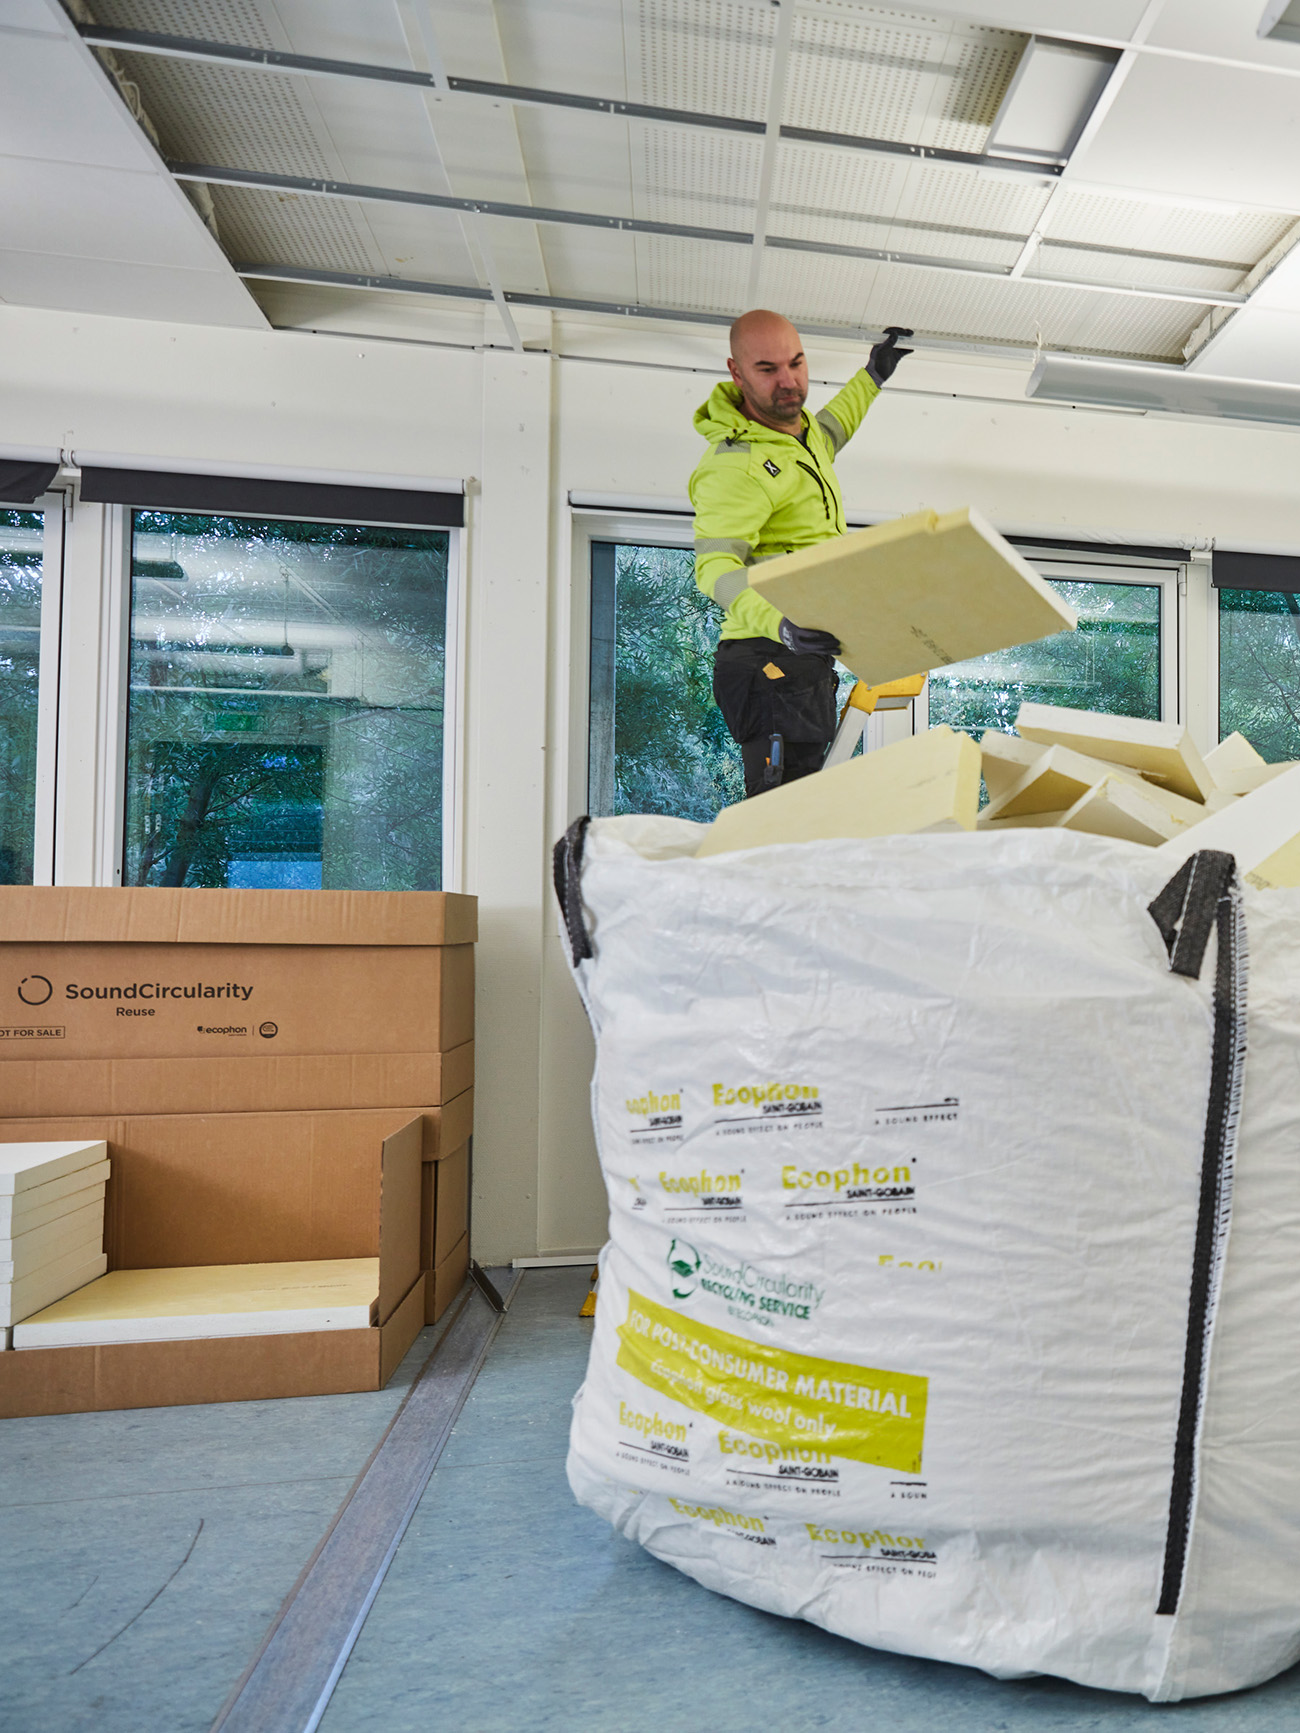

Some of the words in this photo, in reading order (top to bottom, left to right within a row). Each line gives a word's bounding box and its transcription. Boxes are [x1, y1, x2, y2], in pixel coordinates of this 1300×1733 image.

[65, 982, 254, 1001] SoundCircularity
[116, 1007, 156, 1017] Reuse
[13, 1029, 34, 1037] FOR
[36, 1029, 62, 1037] SALE
[205, 1026, 247, 1035] ecophon
[712, 1081, 819, 1108] Ecophon
[659, 1169, 741, 1198] Ecophon
[782, 1162, 911, 1193] Ecophon
[703, 1254, 826, 1309] SoundCircularity
[701, 1278, 755, 1308] RECYCLING
[759, 1296, 811, 1320] SERVICE
[630, 1310, 651, 1338] FOR
[651, 1323, 789, 1393] POST-CONSUMER
[794, 1374, 912, 1419] MATERIAL
[618, 1400, 687, 1443] Ecophon
[705, 1383, 744, 1411] glass
[748, 1400, 792, 1425] wool
[794, 1413, 837, 1442] only
[778, 1464, 839, 1479] SAINT-GOBAIN
[667, 1497, 765, 1533] Ecophon
